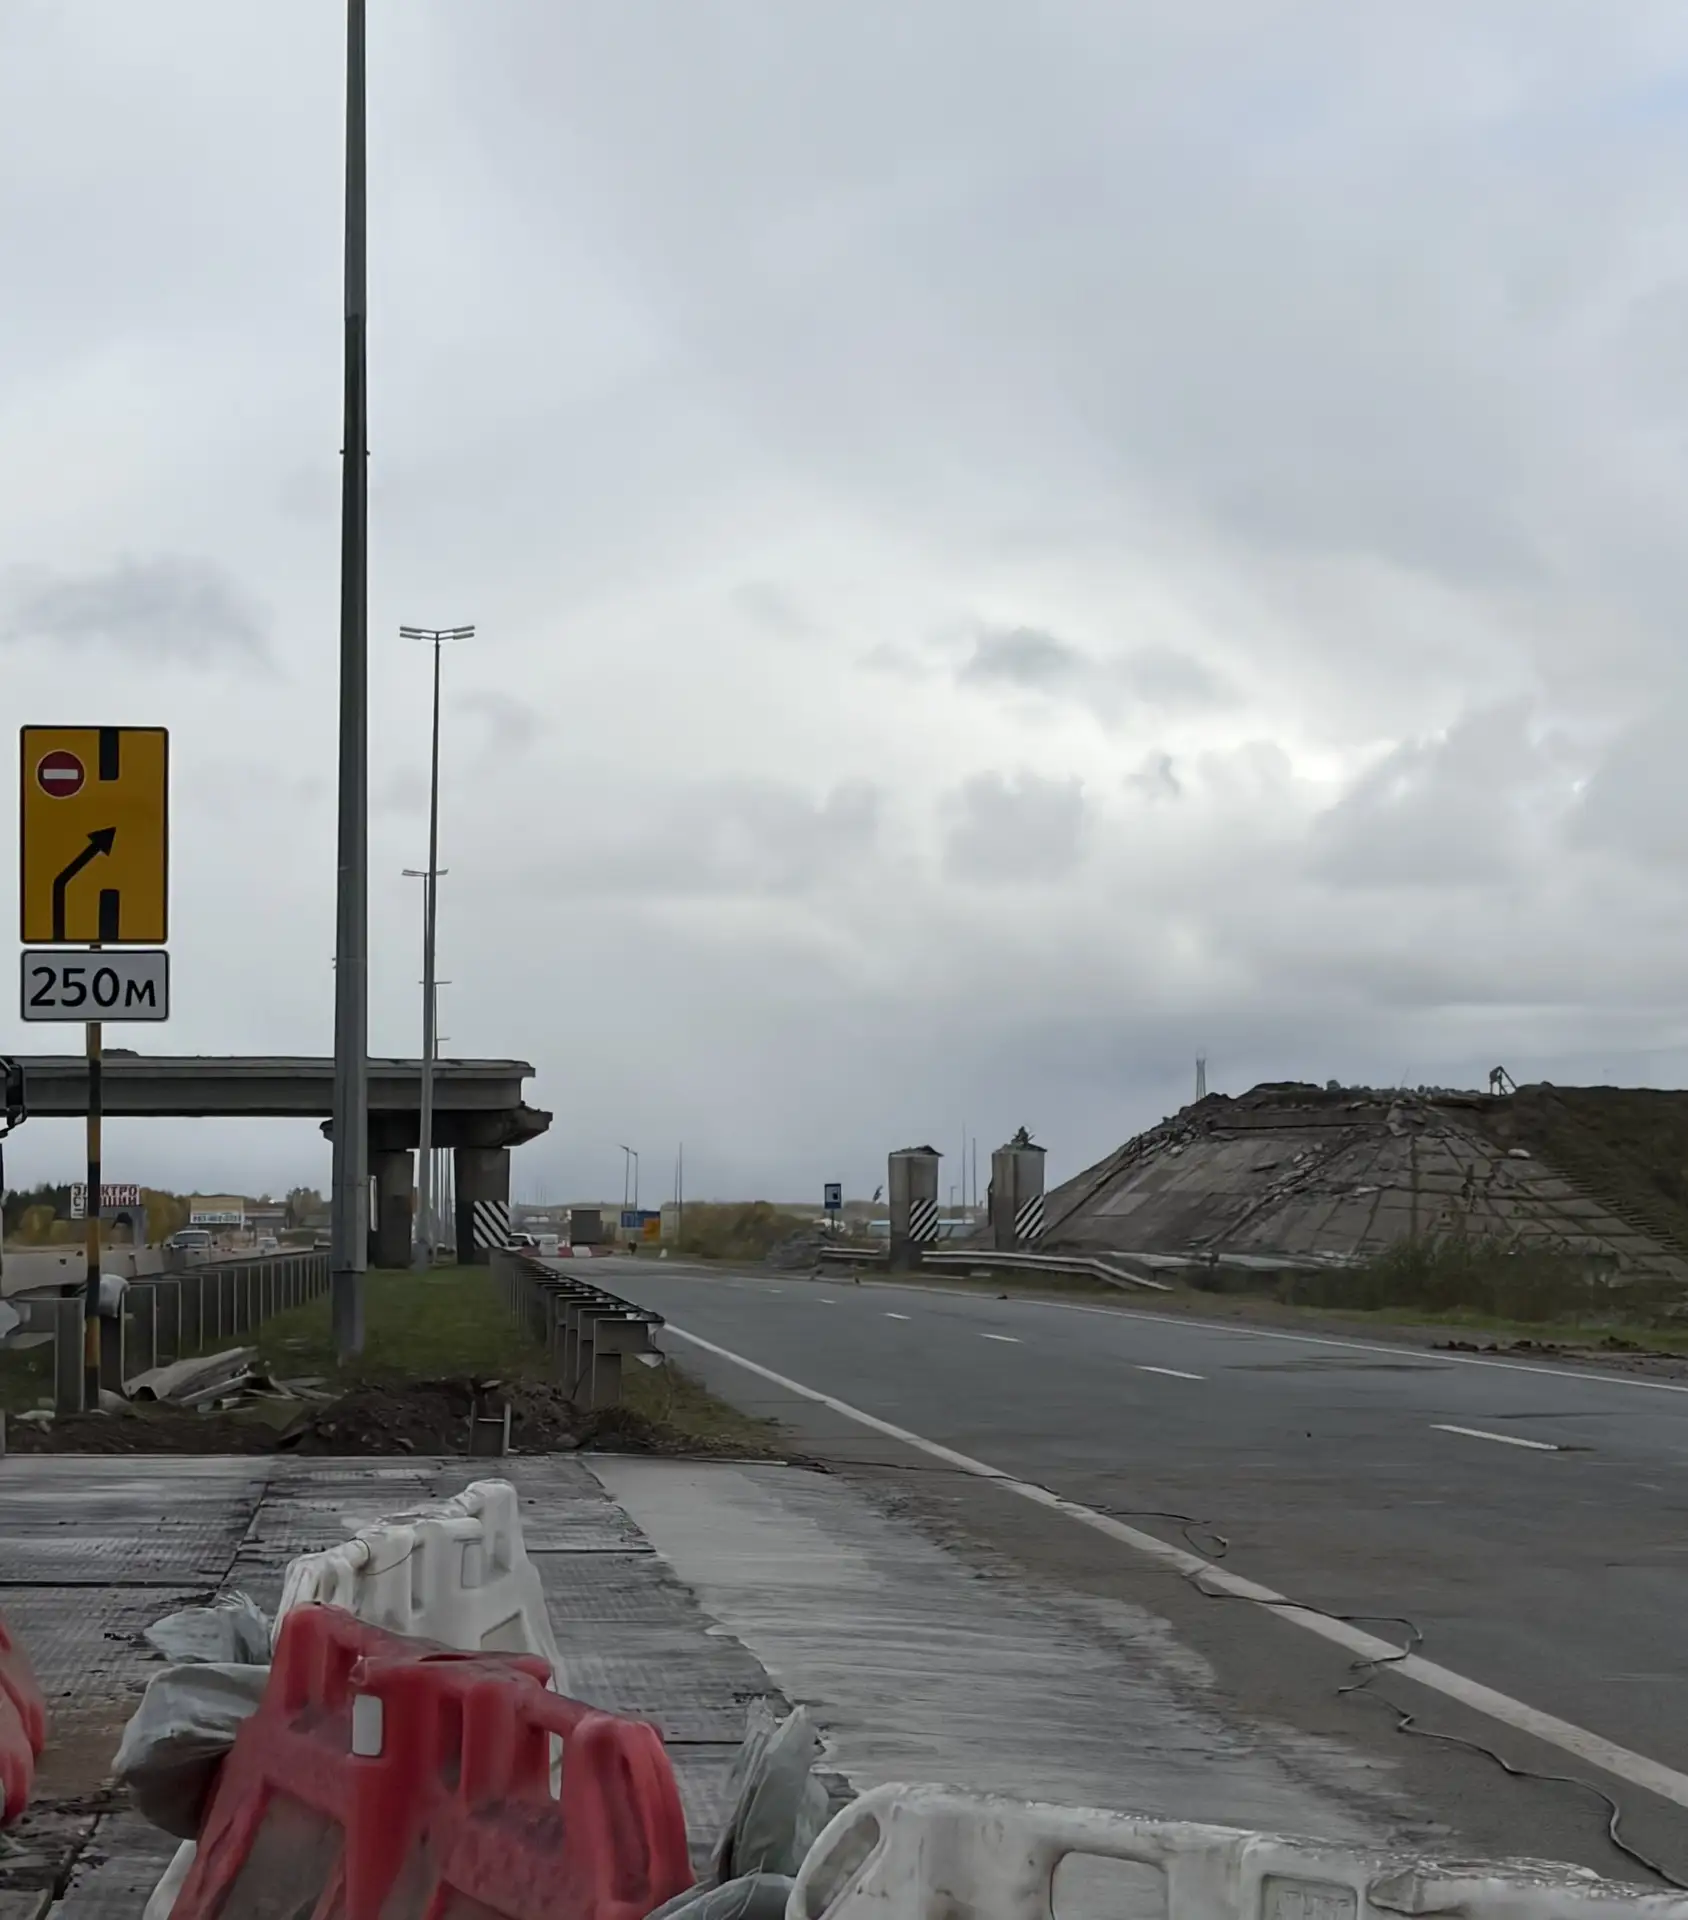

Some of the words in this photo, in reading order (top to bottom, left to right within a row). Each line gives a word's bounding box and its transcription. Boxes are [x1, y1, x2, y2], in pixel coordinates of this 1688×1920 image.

[30, 966, 156, 1008] 250м
[73, 1186, 137, 1196] ЭЛКТРО
[73, 1196, 137, 1207] СТЦИИ
